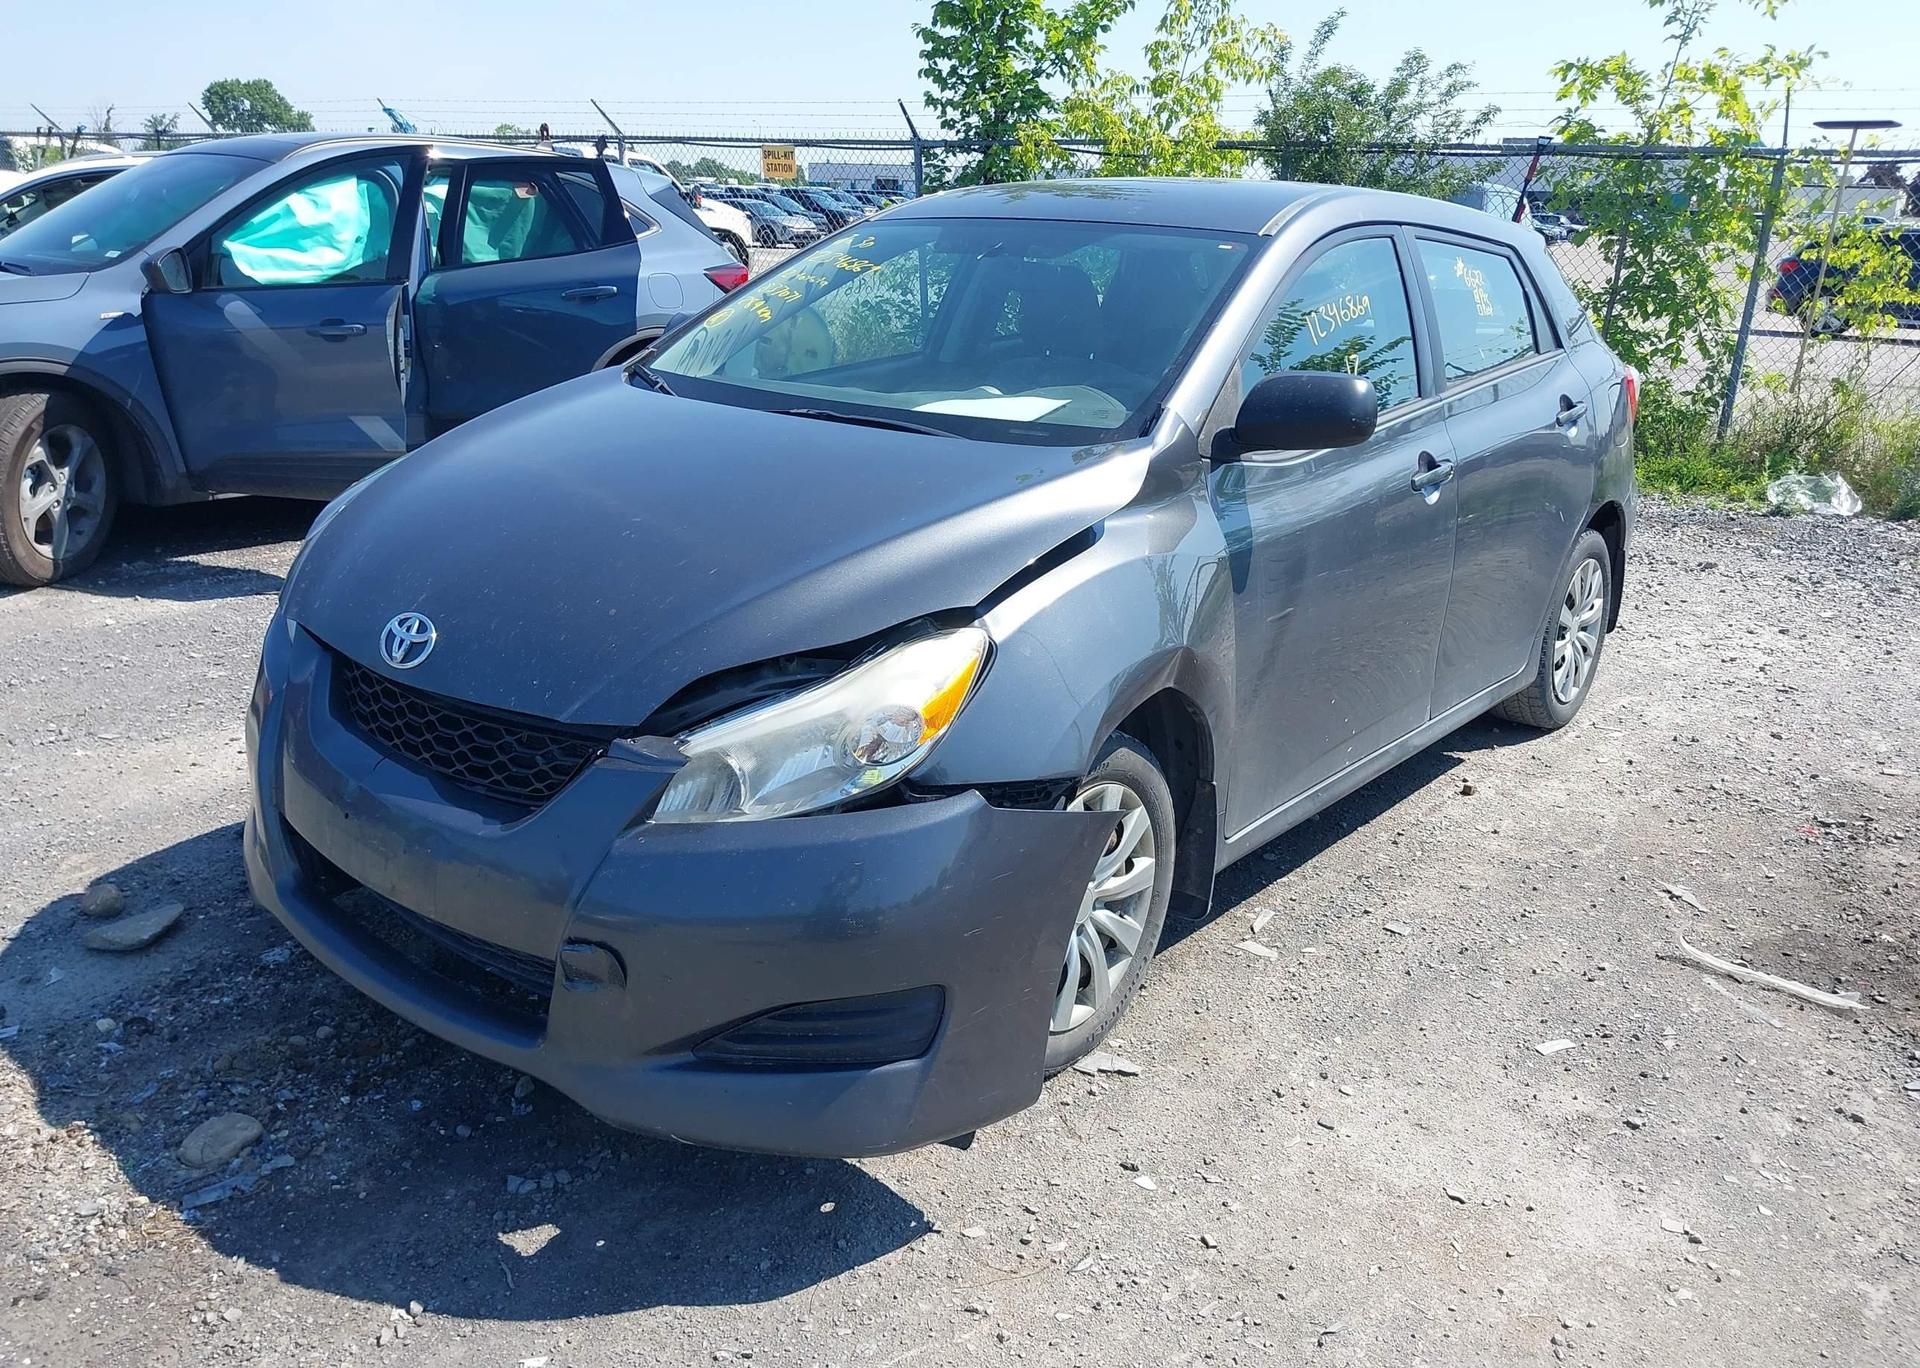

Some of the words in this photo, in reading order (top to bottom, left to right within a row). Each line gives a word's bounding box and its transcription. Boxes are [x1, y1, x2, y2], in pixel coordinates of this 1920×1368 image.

[763, 150, 794, 160] SPILL-KIT
[766, 163, 793, 173] STATION
[1304, 294, 1373, 346] 12346869
